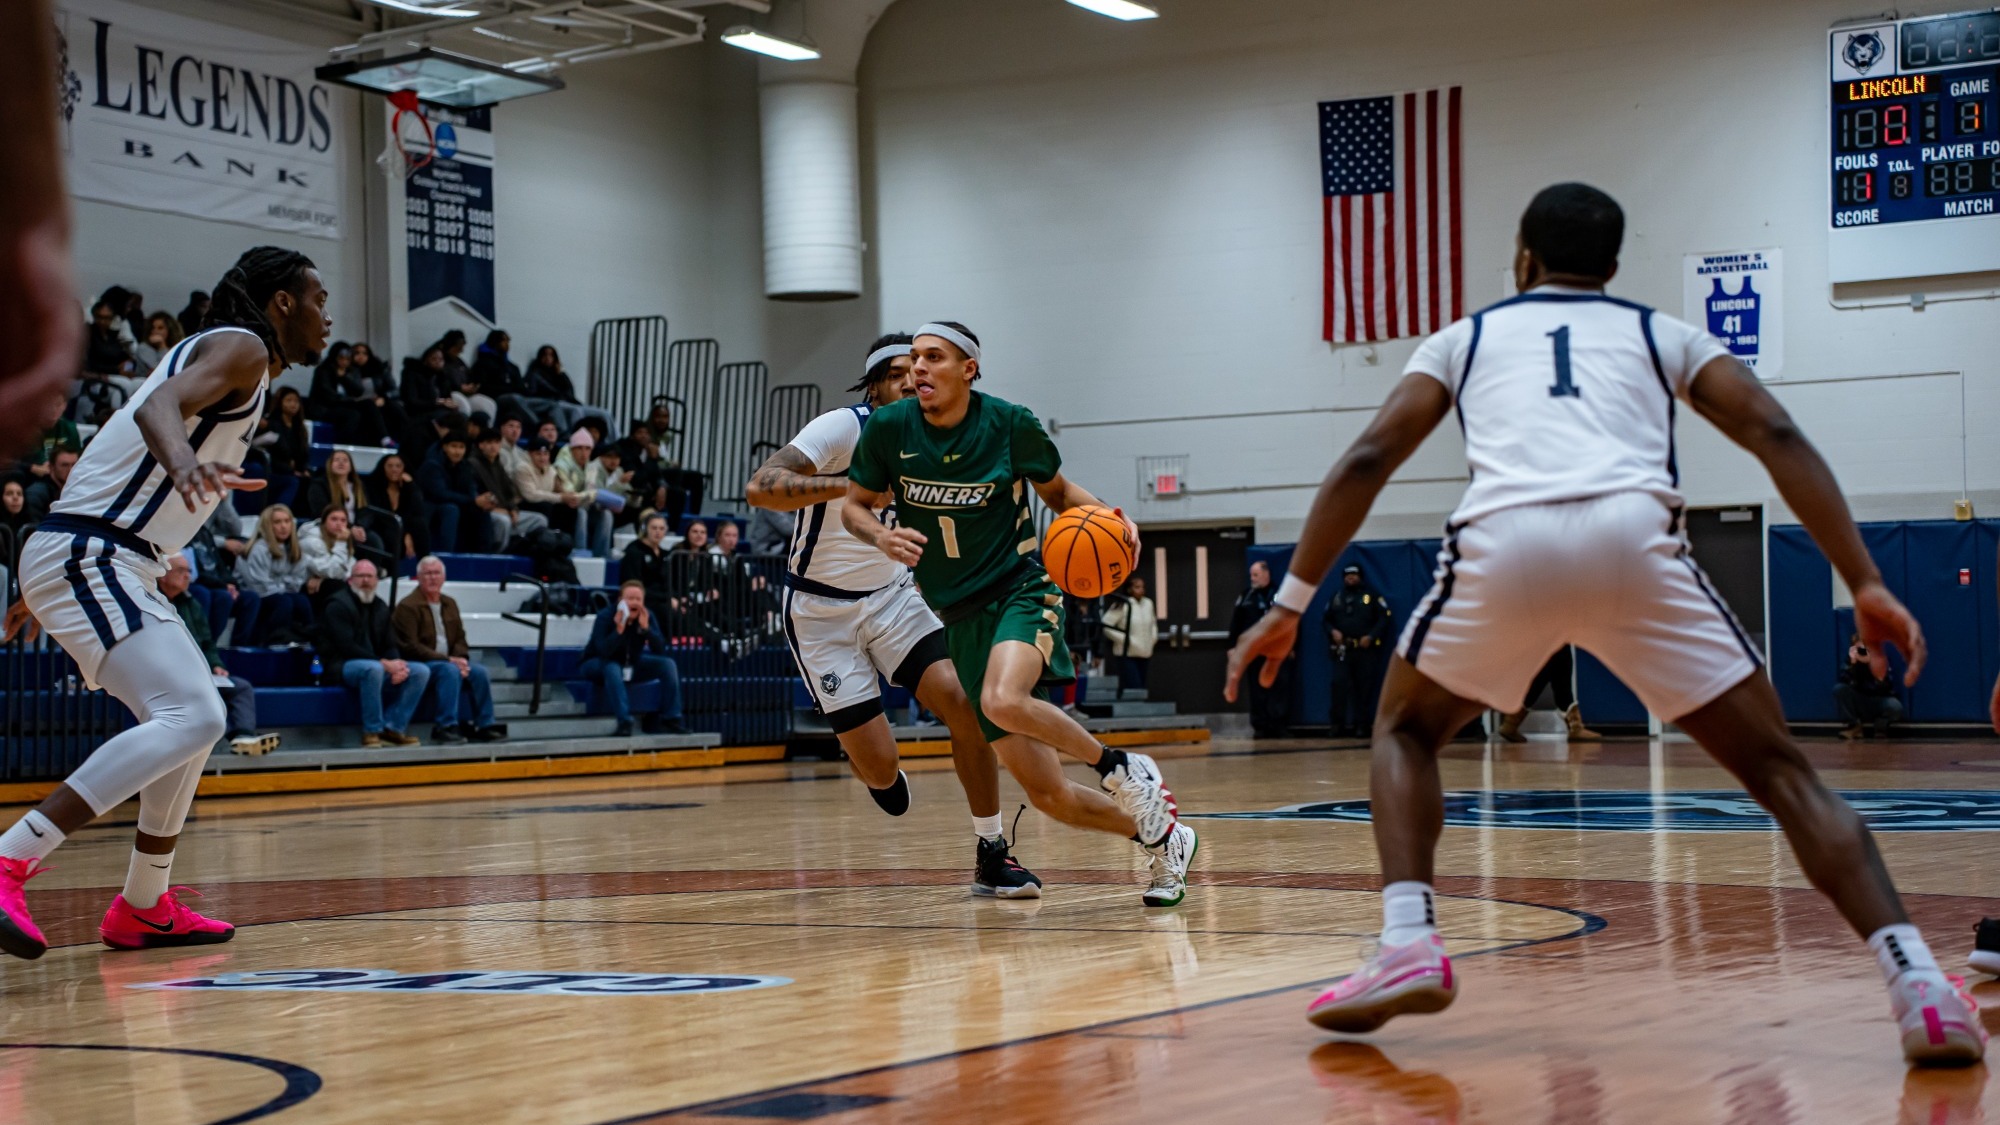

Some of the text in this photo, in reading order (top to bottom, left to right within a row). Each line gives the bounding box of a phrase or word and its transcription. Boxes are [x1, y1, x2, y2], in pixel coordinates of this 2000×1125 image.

[89, 17, 331, 154] LEGENDS
[1850, 75, 1926, 100] LINCOLN
[1950, 79, 1990, 97] GAME
[1835, 153, 1878, 171] FOULS
[1922, 144, 1974, 162] PLAYER
[123, 138, 310, 189] BANK
[1888, 159, 1914, 172] T.O.L.
[1945, 198, 1993, 216] MATCH
[1836, 209, 1879, 226] SCORE
[1697, 262, 1769, 275] BASKETBALL
[1711, 298, 1755, 312] LINCOLN
[1722, 314, 1741, 334] 41
[1545, 324, 1580, 398] 1
[907, 483, 986, 504] MINERS
[938, 516, 960, 558] 1
